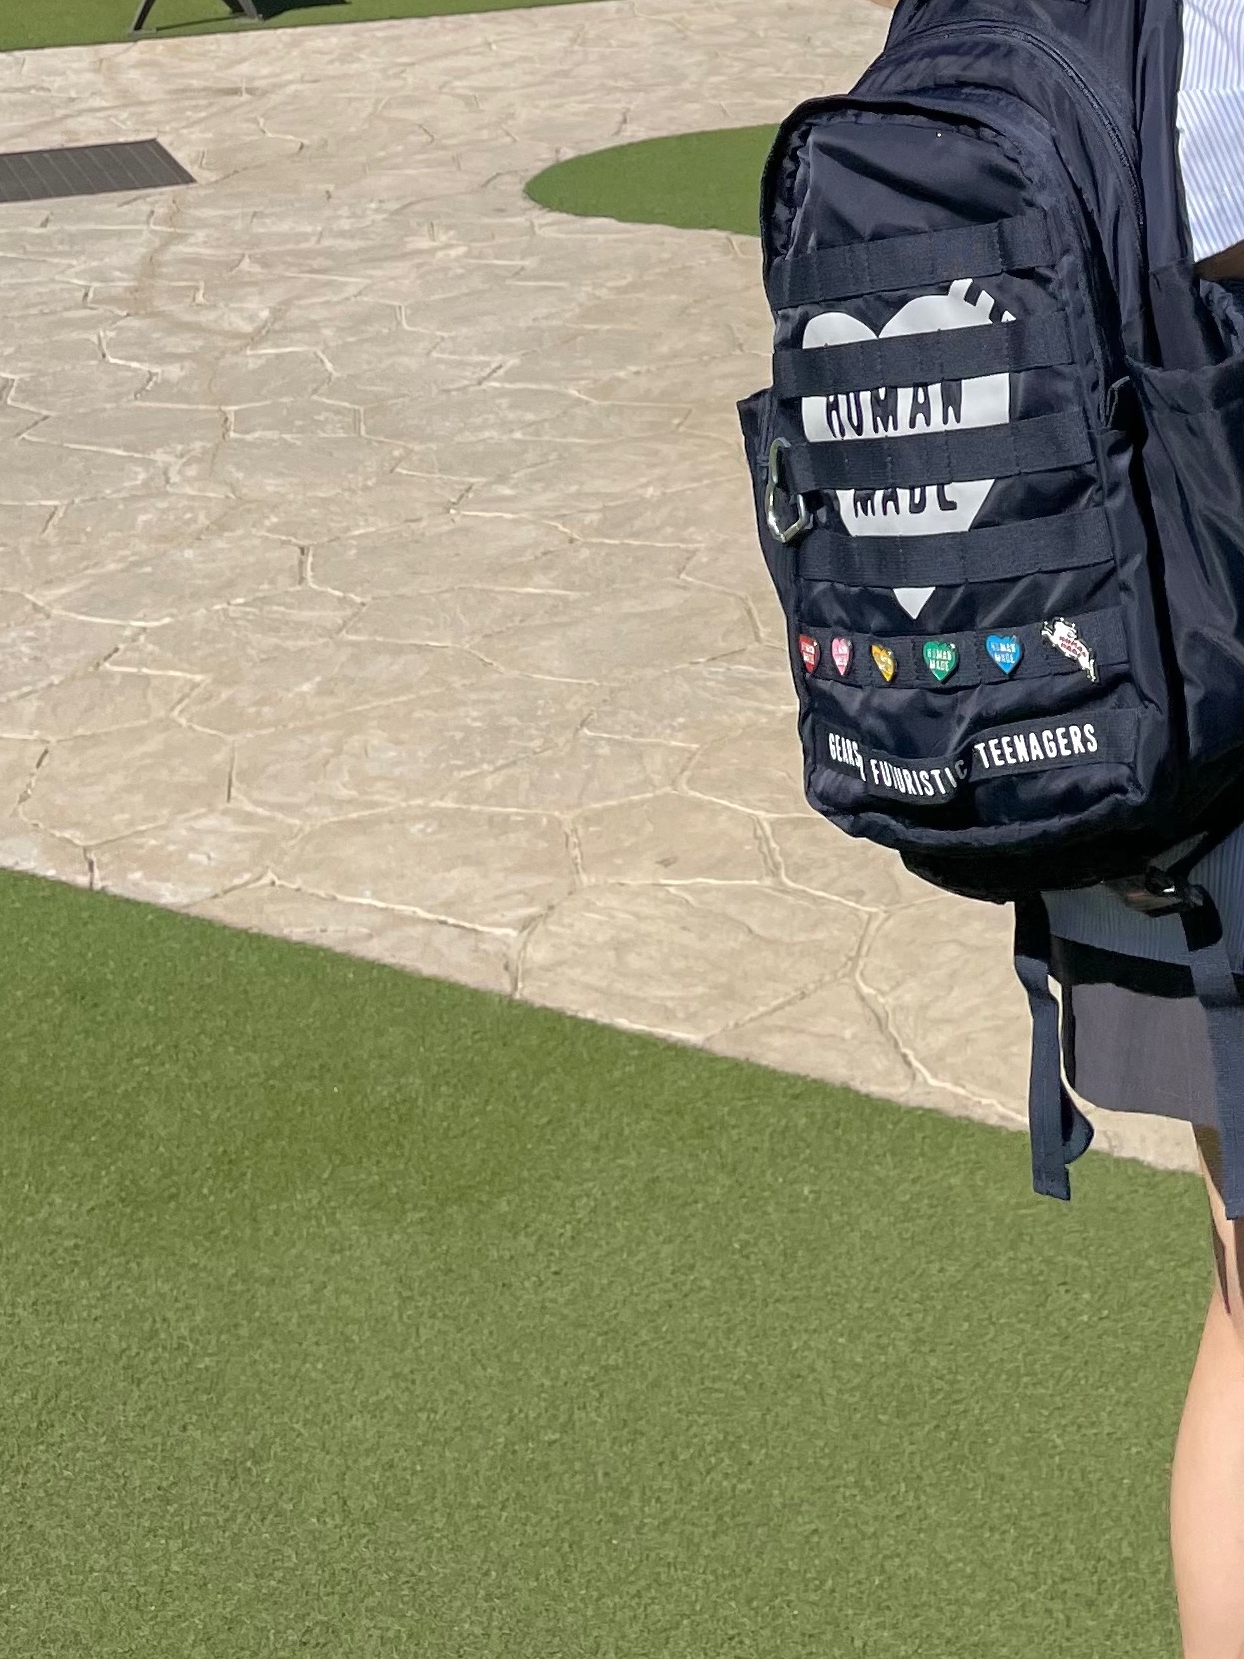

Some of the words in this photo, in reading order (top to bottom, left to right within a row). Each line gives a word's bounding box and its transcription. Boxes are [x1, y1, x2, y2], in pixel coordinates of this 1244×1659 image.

[826, 384, 962, 439] HUMAN
[828, 733, 862, 769] GEARS
[974, 723, 1098, 769] TEENAGERS
